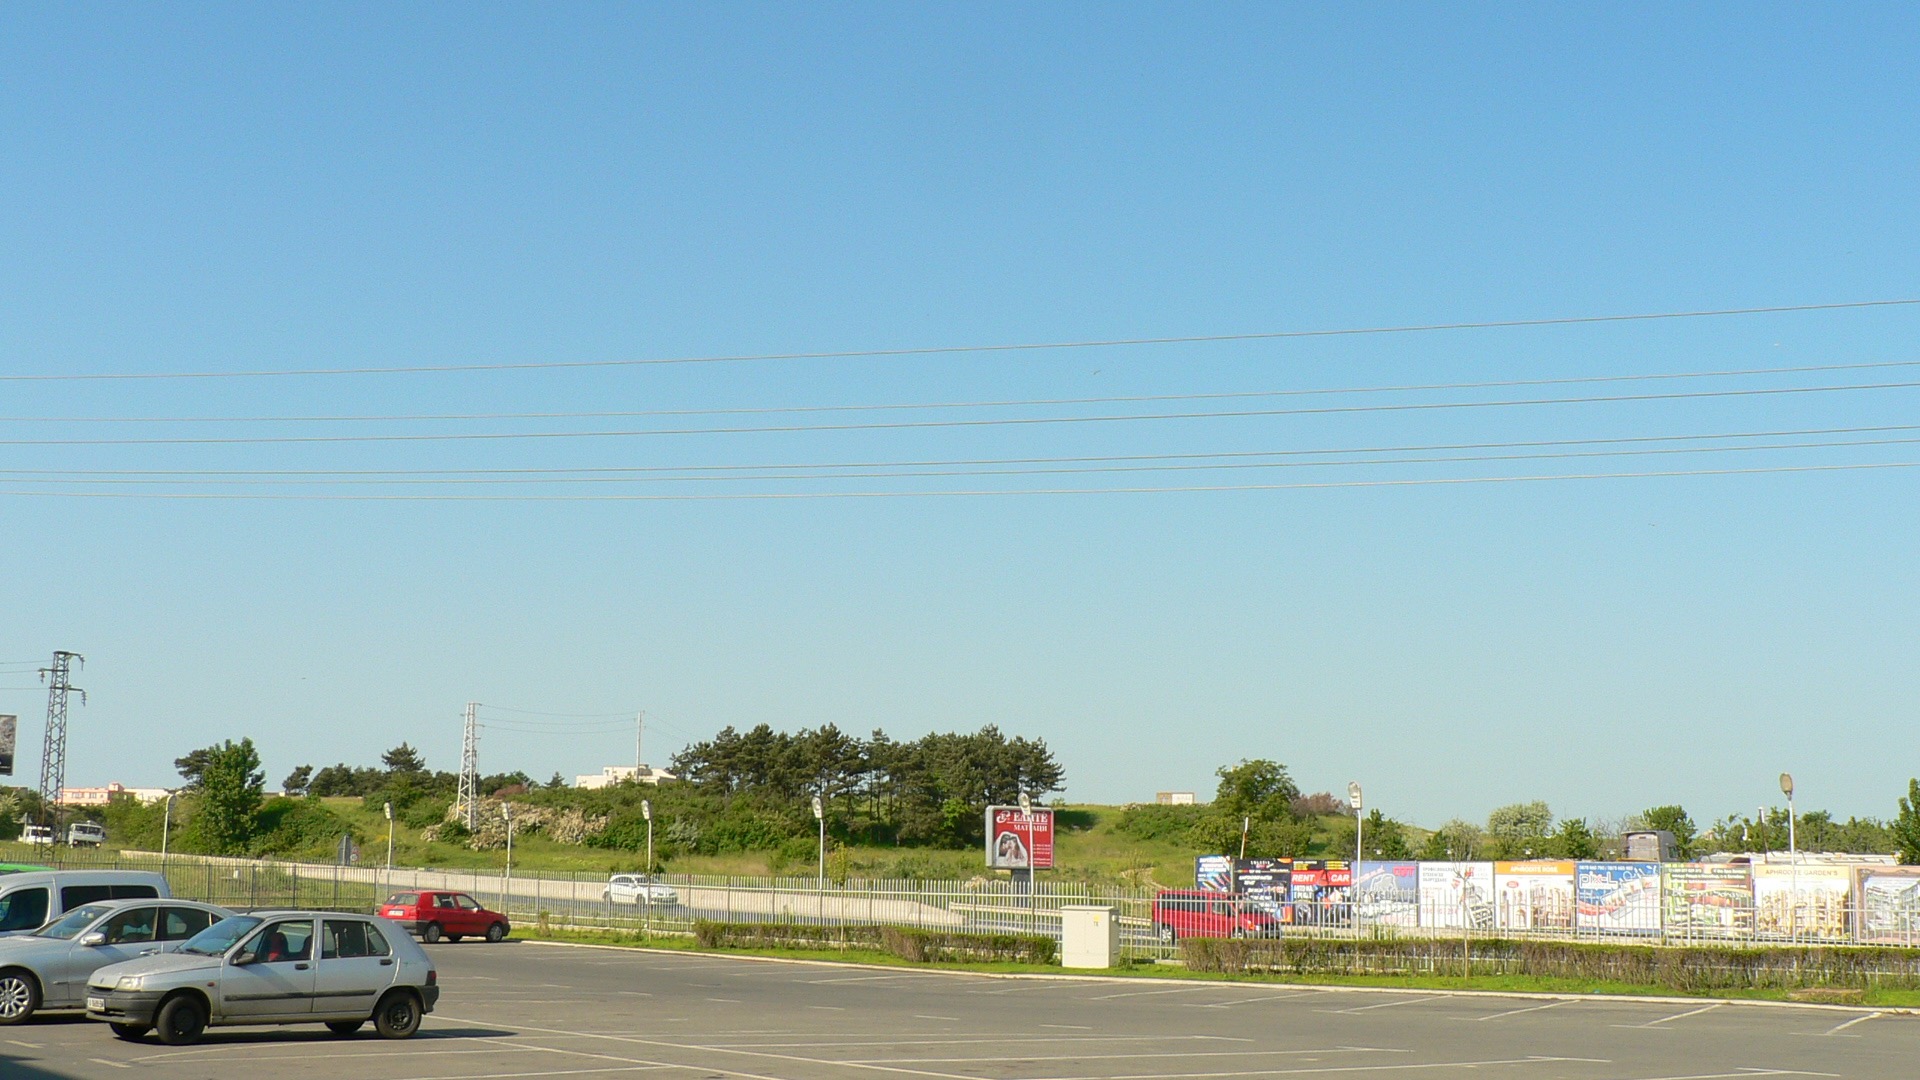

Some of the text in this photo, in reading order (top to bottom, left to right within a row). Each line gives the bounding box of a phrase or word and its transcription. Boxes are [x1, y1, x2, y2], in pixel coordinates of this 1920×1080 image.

[1013, 824, 1048, 832] МАТАЦИ
[1291, 874, 1315, 882] RENT
[1331, 874, 1350, 883] CAR
